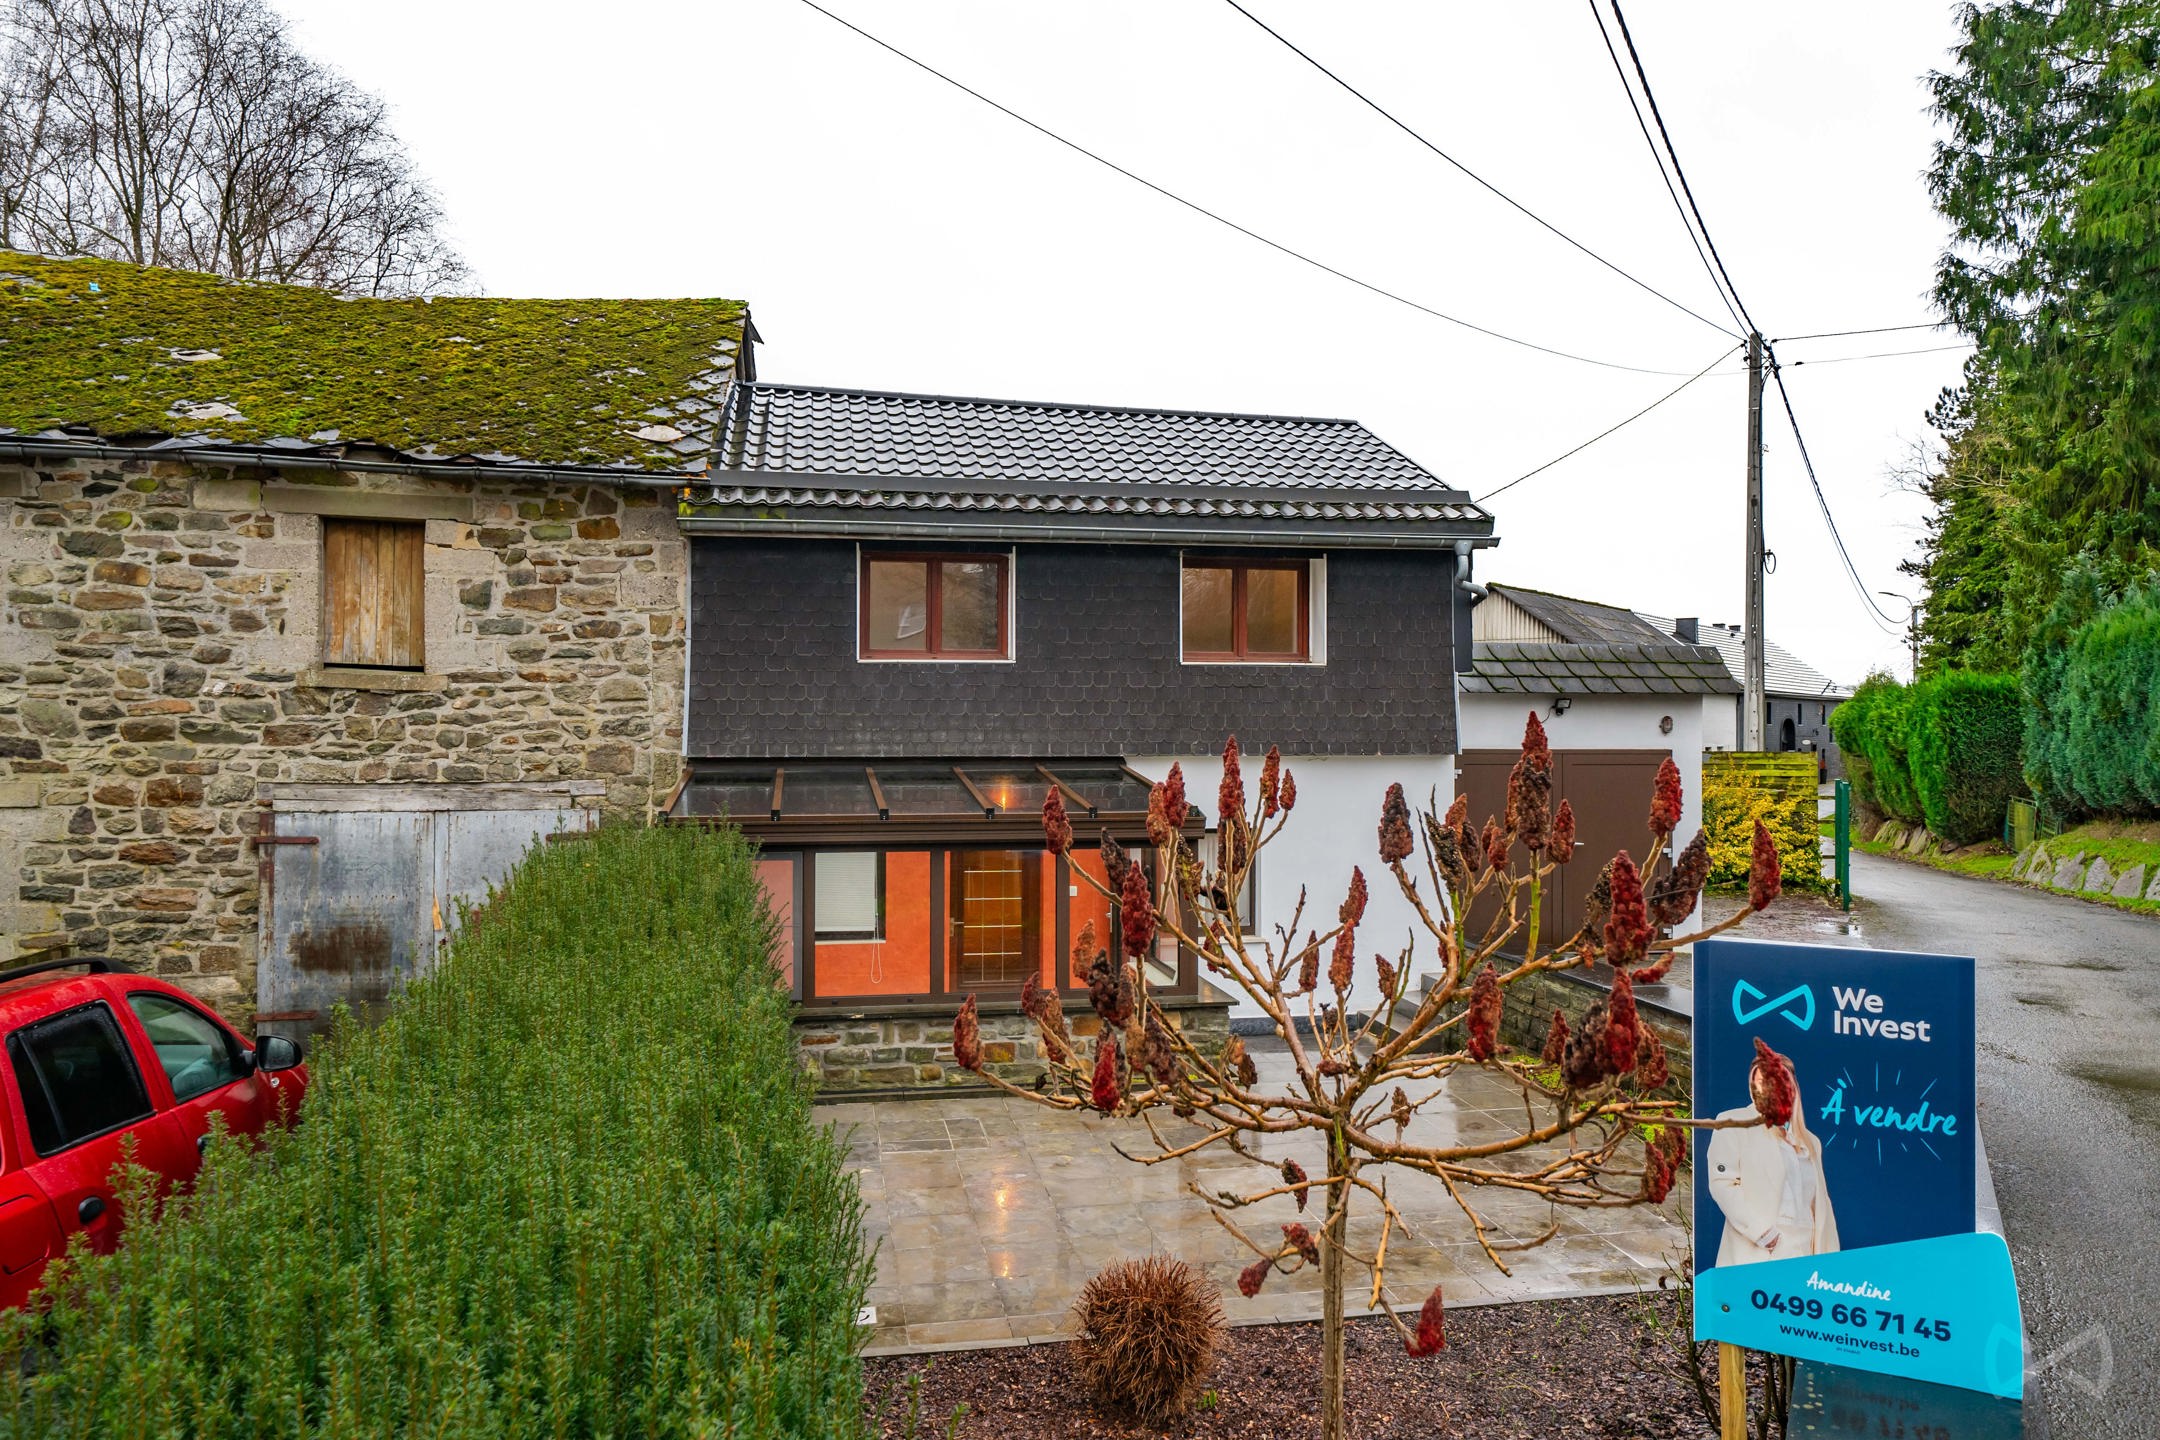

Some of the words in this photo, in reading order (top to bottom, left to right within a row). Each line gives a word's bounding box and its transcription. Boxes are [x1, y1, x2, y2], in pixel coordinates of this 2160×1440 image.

[1832, 986, 1884, 1013] We
[1834, 1010, 1931, 1042] Invest
[1820, 1078, 1847, 1125] À
[1853, 1101, 1958, 1136] vendre
[1806, 1271, 1892, 1301] Amandine
[1751, 1289, 1823, 1320] 0499
[1831, 1303, 1868, 1328] 66
[1875, 1310, 1905, 1335] 71
[1913, 1317, 1952, 1342] 45
[1780, 1324, 1920, 1358] www.weinvest.be
